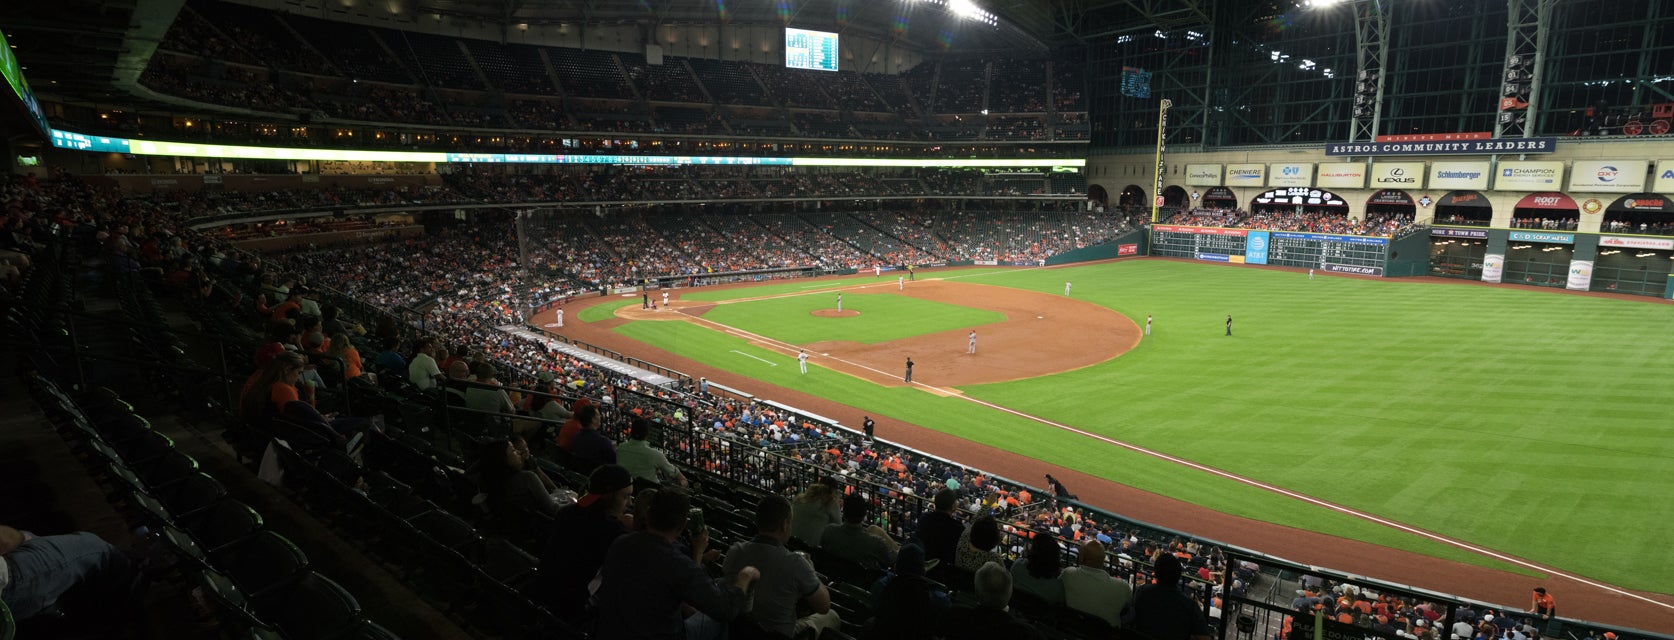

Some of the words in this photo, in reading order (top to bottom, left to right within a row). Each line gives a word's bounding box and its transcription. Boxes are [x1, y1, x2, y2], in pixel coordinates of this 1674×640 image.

[1332, 145, 1377, 153] ASTROS
[1383, 143, 1470, 152] COMMUNITY
[1475, 141, 1546, 150] LEADERS
[1437, 171, 1481, 180] Schlumberger
[1248, 251, 1264, 259] AT&T
